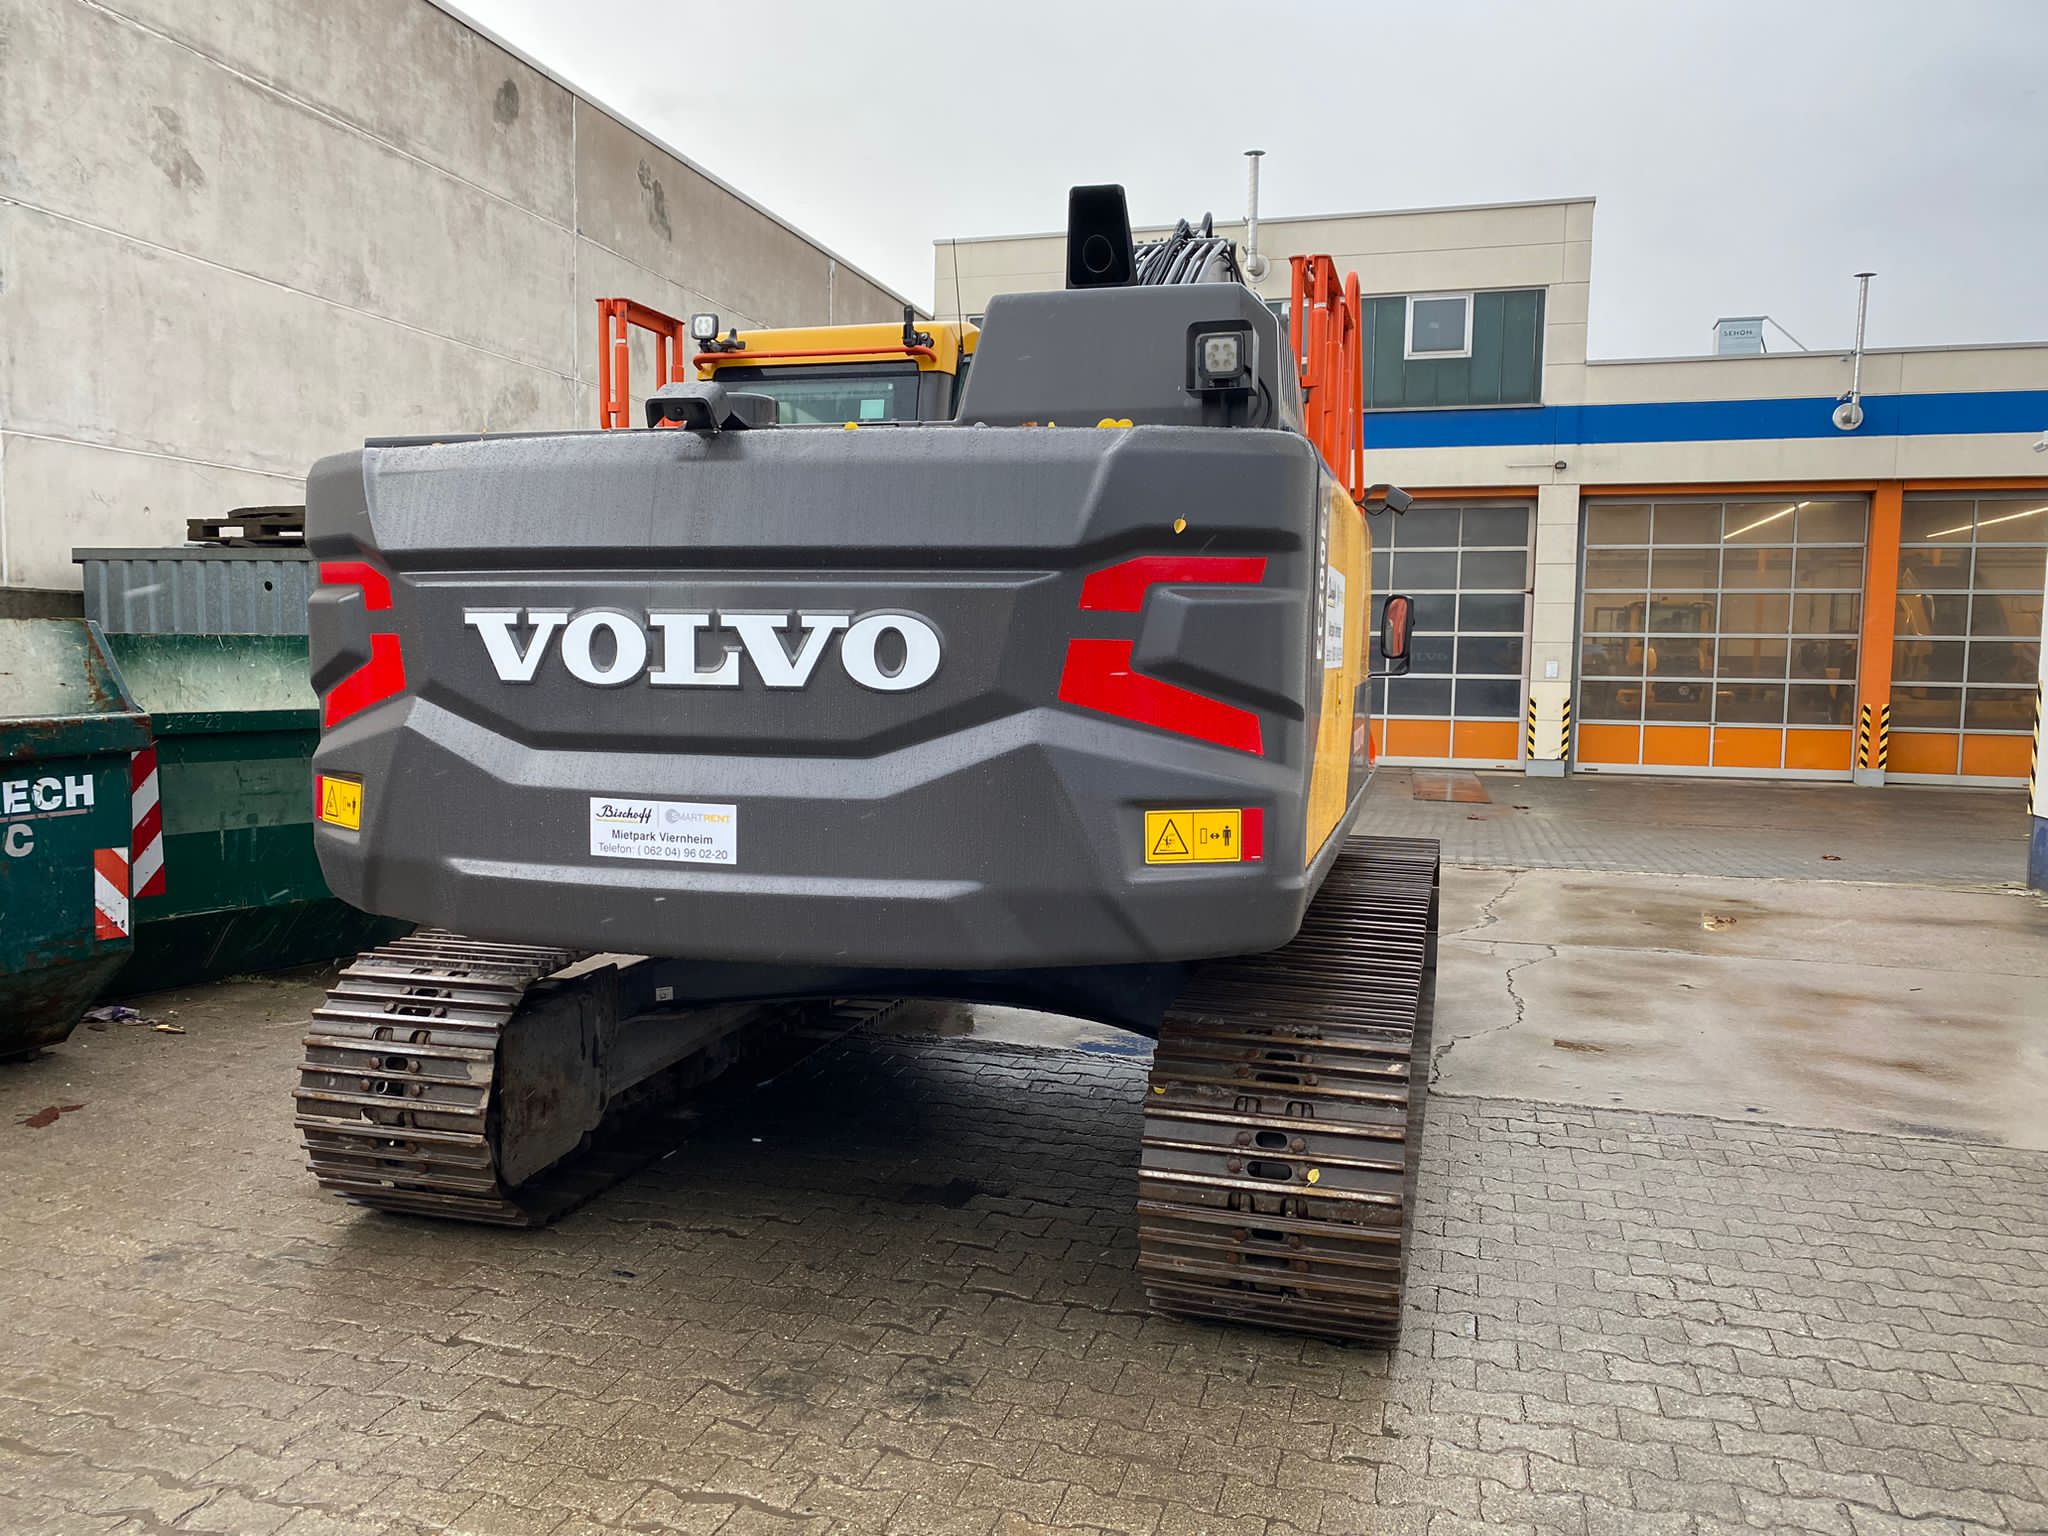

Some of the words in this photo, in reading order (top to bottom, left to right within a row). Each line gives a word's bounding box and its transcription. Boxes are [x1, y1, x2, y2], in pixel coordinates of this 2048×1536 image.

[464, 610, 942, 691] VOLVO
[0, 774, 95, 814] ECH
[596, 804, 652, 824] Bischoff
[612, 829, 656, 843] Mietpark
[659, 832, 713, 845] Viernheim
[599, 841, 635, 854] Telefon:
[683, 848, 697, 859] 96
[699, 849, 728, 860] 02-20
